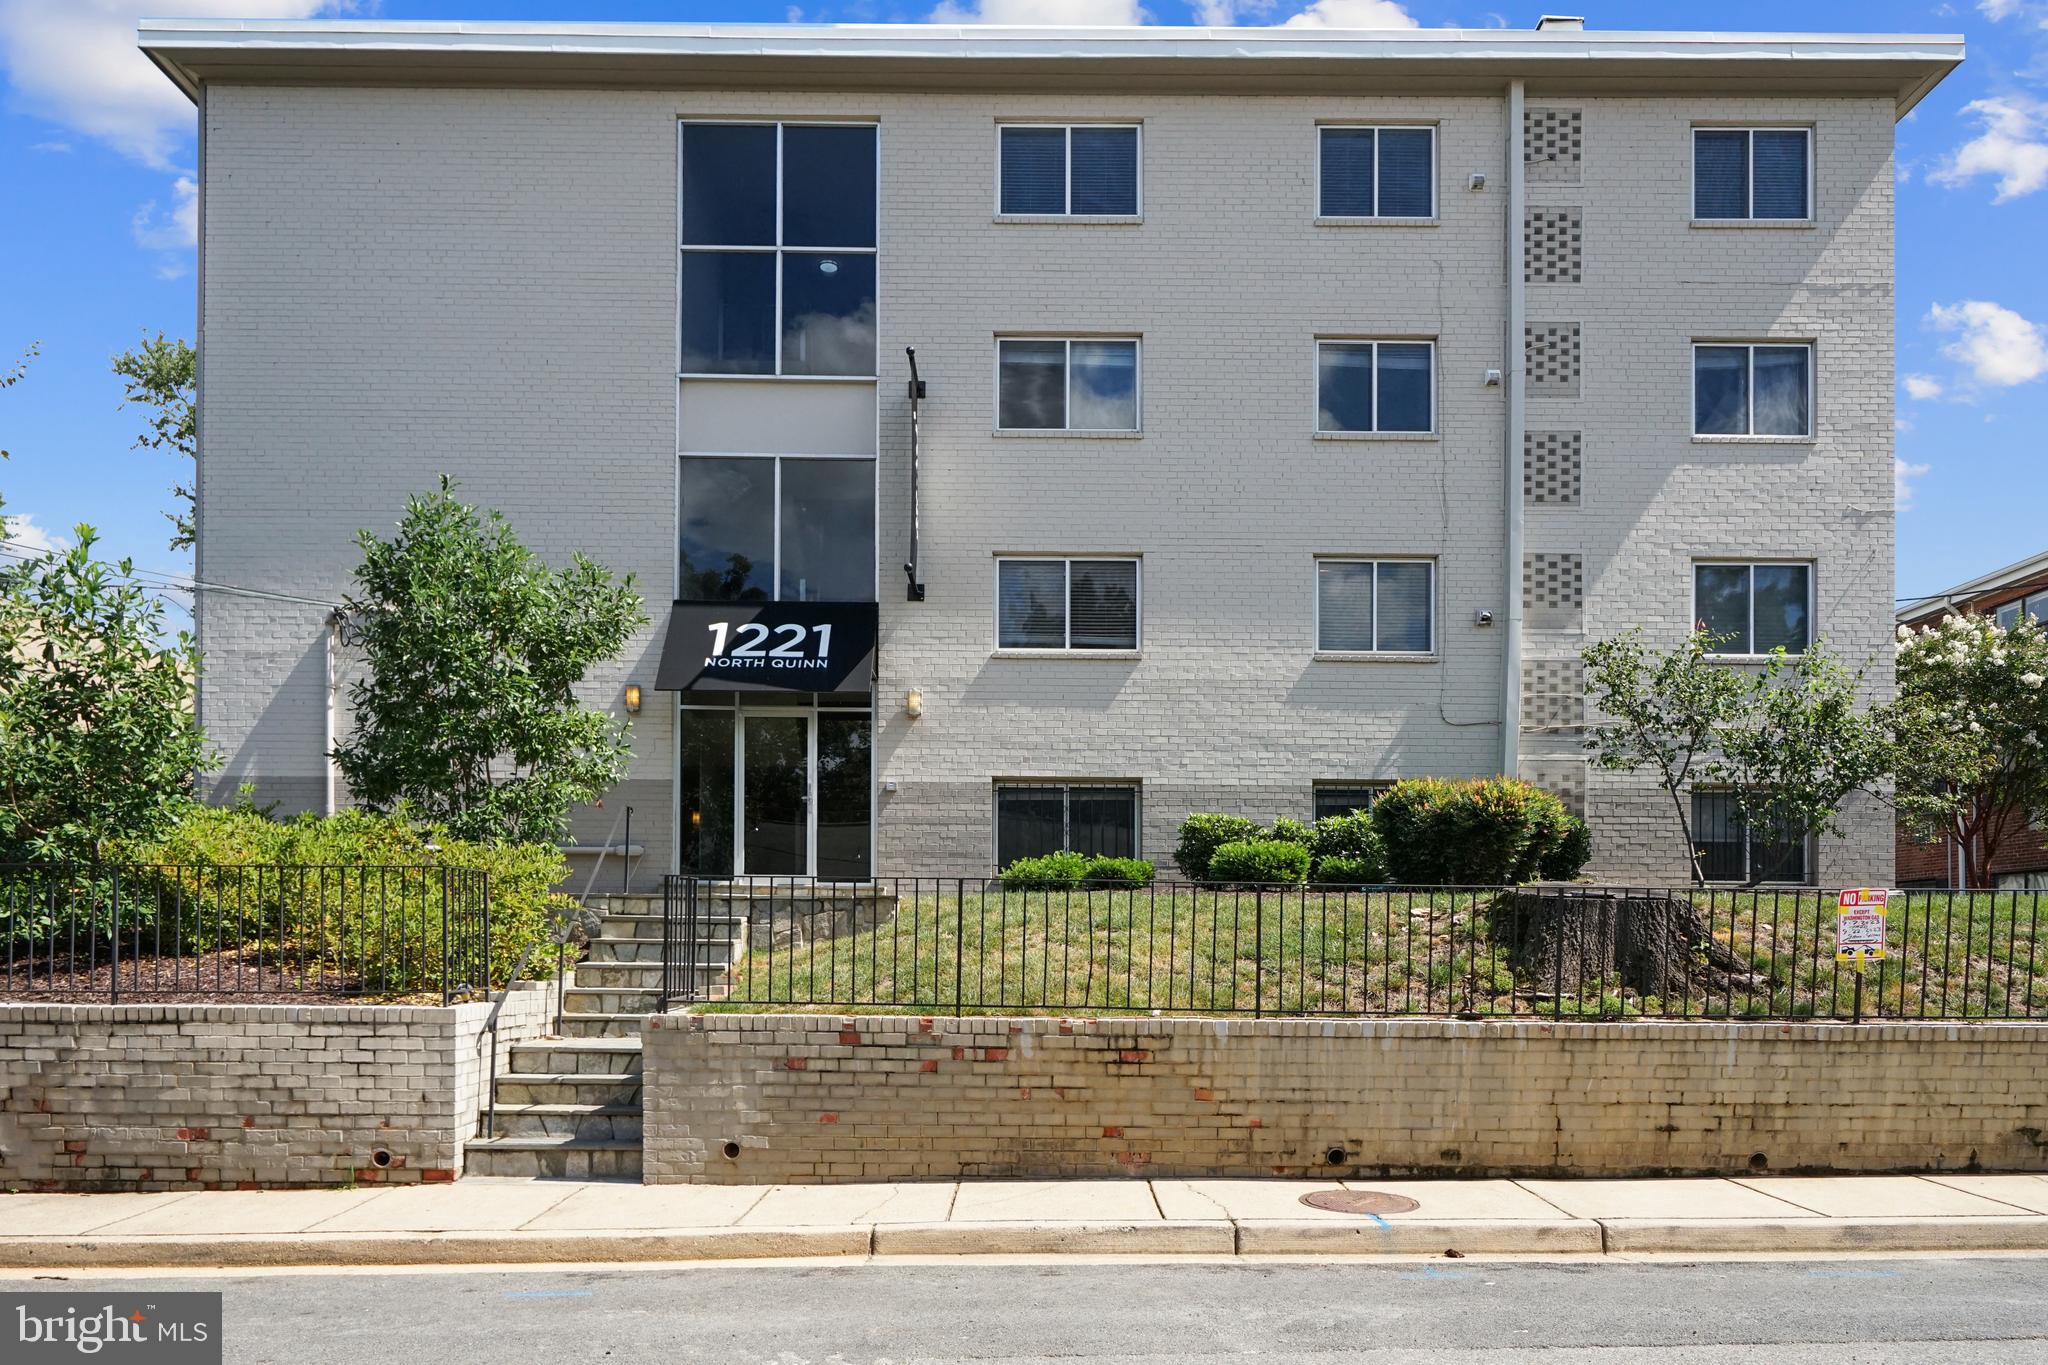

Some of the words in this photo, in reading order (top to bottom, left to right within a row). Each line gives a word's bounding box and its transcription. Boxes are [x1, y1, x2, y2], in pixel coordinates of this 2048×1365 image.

[708, 622, 832, 658] 1221
[704, 657, 765, 668] NORTH
[771, 659, 828, 669] QUINN
[1843, 892, 1857, 905] NO
